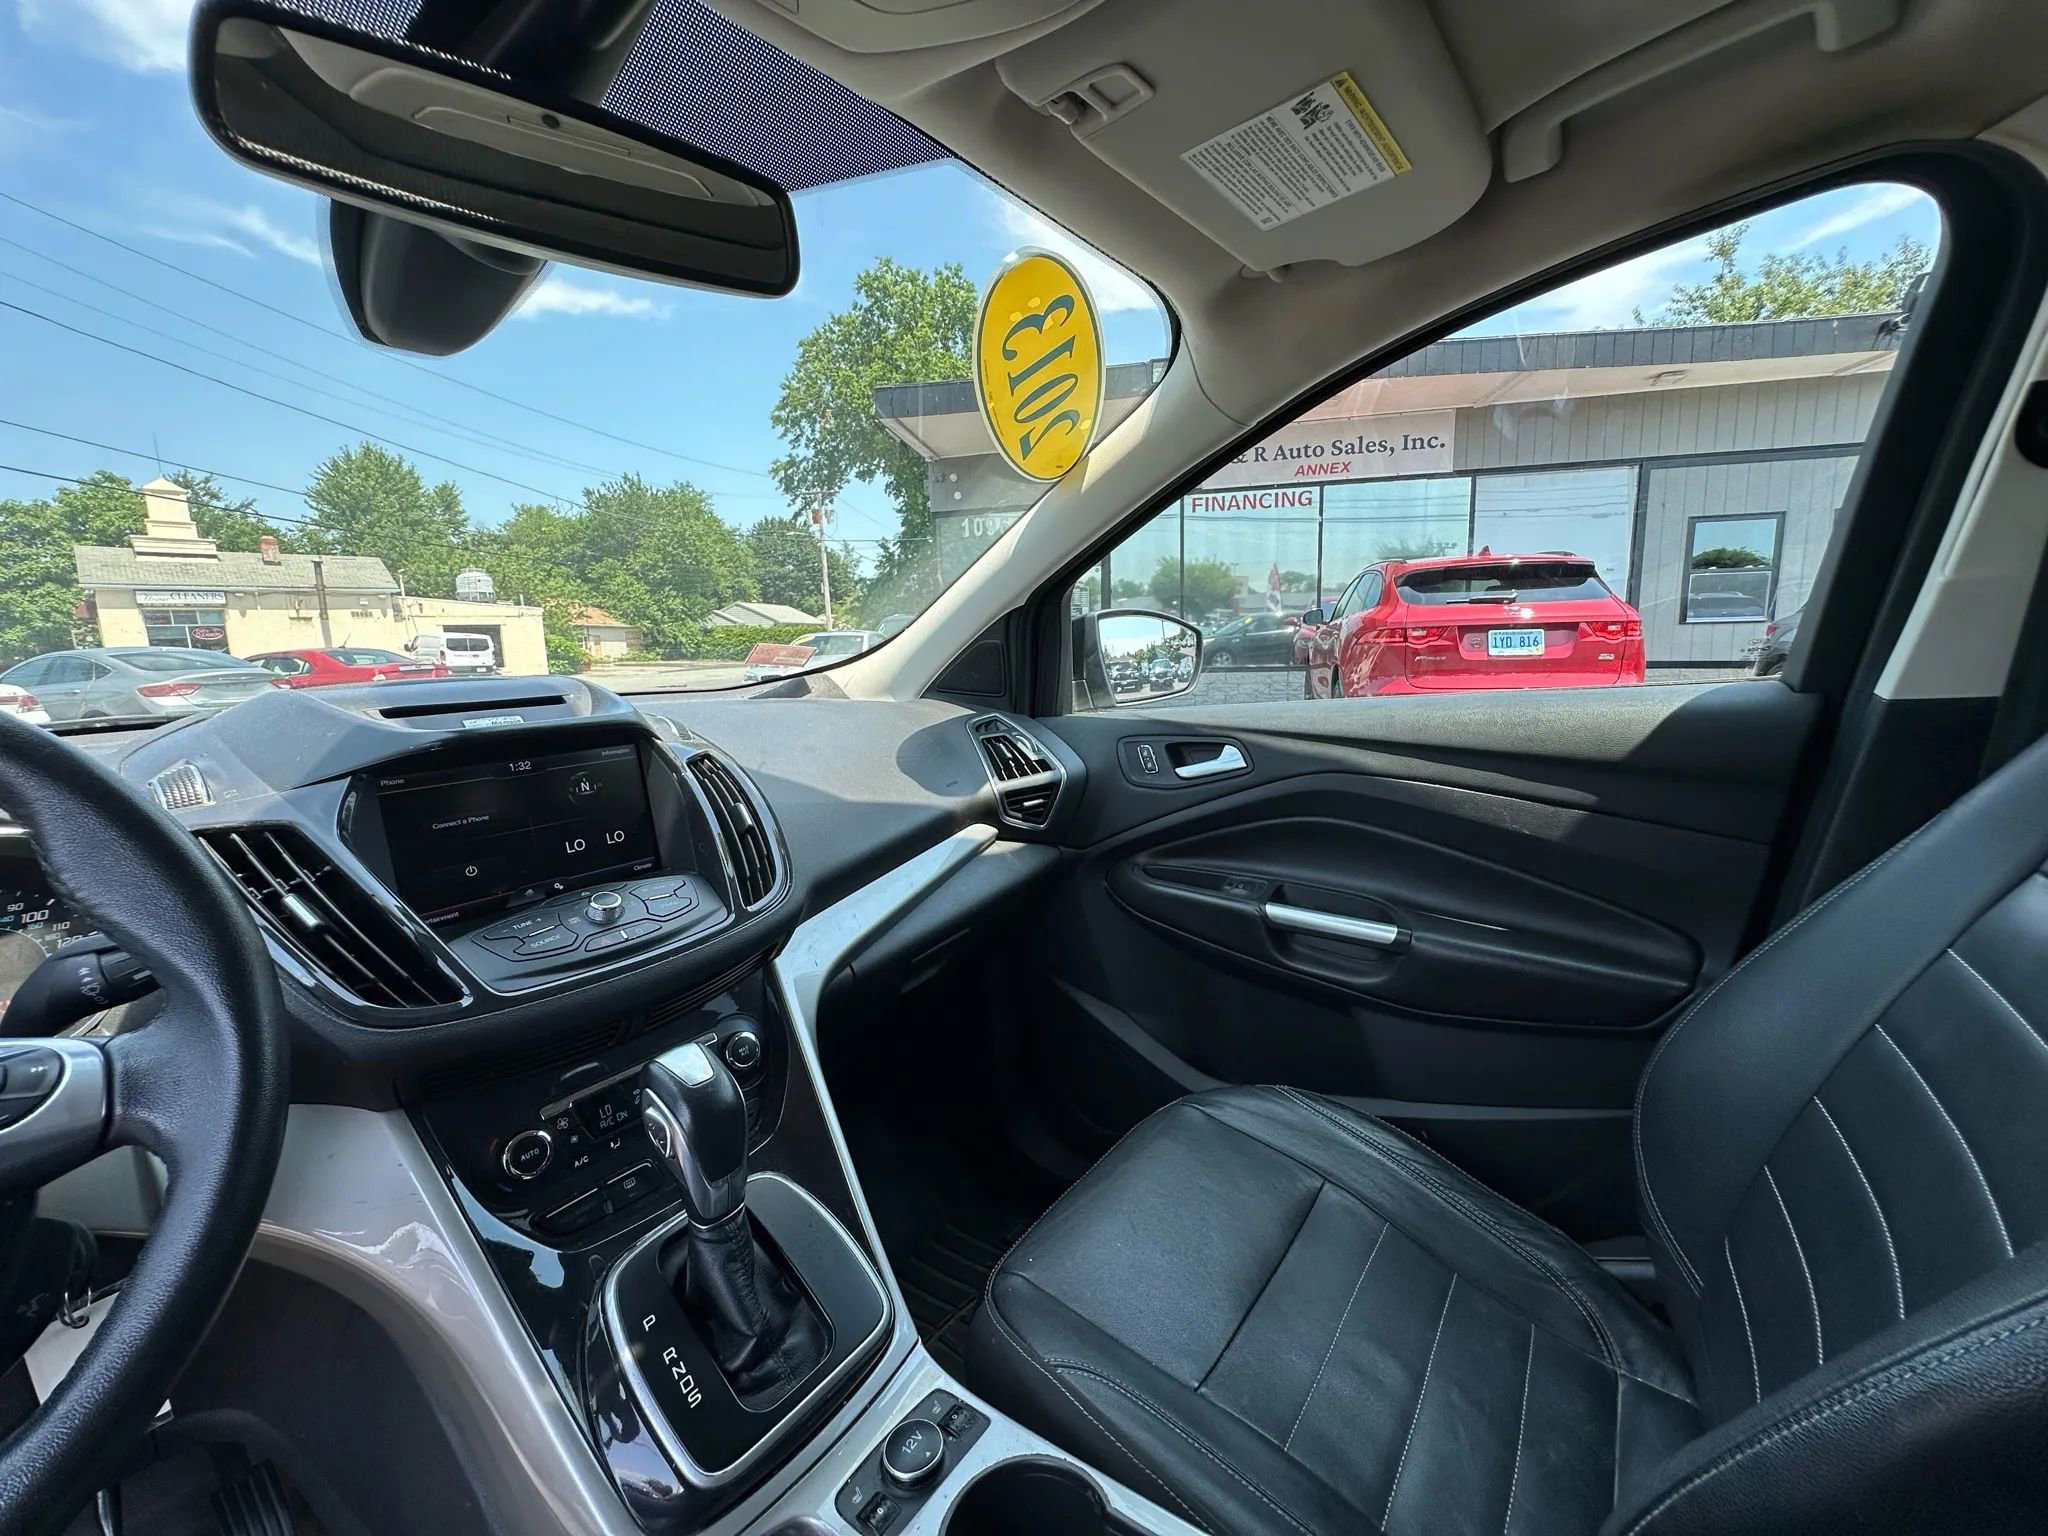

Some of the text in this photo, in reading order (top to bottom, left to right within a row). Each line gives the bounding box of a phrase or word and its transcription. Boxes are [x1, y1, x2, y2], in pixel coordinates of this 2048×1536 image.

[1253, 446, 1269, 463] R
[1273, 444, 1325, 461] Auto
[1331, 436, 1395, 456] Sales,
[1402, 434, 1446, 450] Inc.
[1294, 461, 1352, 477] ANNEX
[1191, 490, 1313, 513] FINANCING
[170, 592, 225, 600] CLEANERS
[1520, 635, 1539, 648] 816
[509, 761, 532, 772] 1:32
[380, 778, 405, 787] Phone
[580, 781, 590, 792] N
[432, 818, 462, 830] Connect
[468, 814, 490, 824] Phone
[606, 830, 625, 845] LO
[566, 839, 586, 853] LO
[7, 902, 24, 912] 90
[20, 910, 49, 924] 100
[52, 921, 71, 931] 110
[512, 920, 533, 930] TUNE
[530, 935, 560, 948] SOURCE
[520, 1148, 540, 1161] AUTO
[574, 1155, 589, 1168] A/C
[642, 1314, 656, 1332] P
[901, 1430, 923, 1454] 12V
